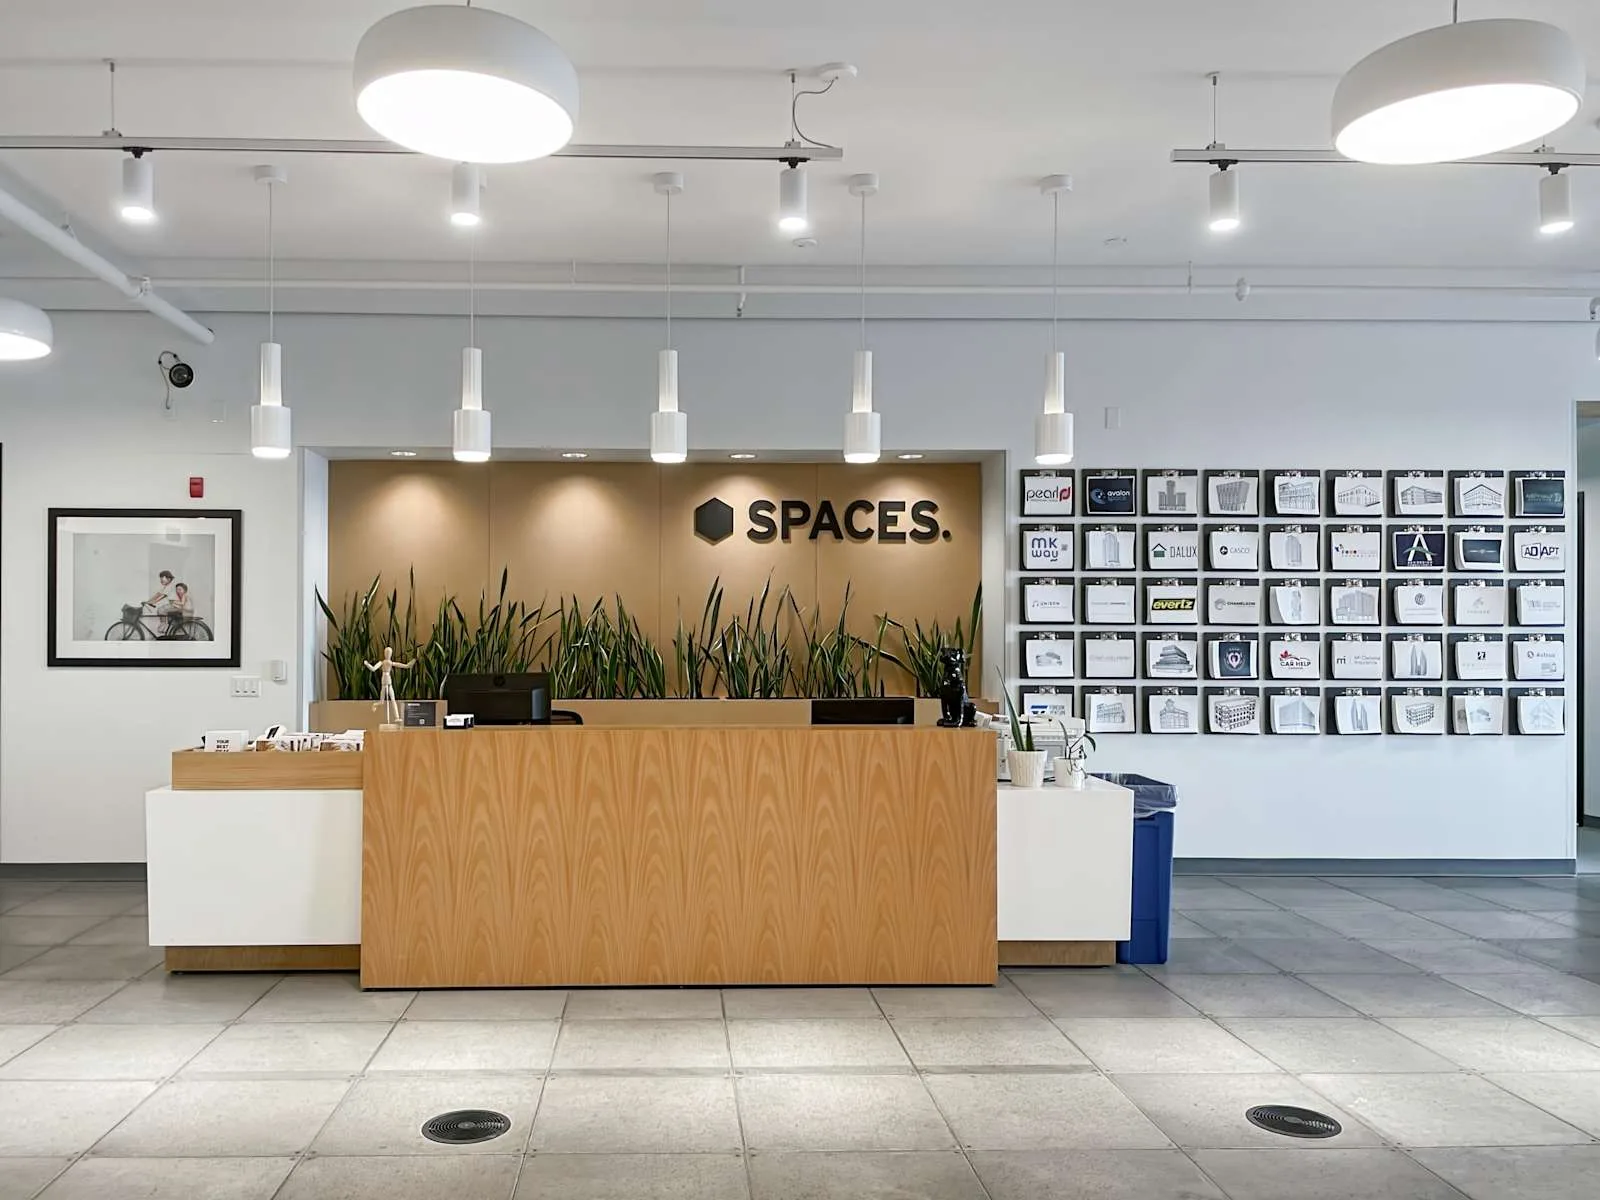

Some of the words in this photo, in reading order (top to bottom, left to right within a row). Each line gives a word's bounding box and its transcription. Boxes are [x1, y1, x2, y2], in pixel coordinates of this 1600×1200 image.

[1026, 486, 1059, 502] pearl
[1107, 489, 1130, 497] avalon
[1031, 550, 1059, 562] way
[1169, 546, 1198, 558] DALUX
[1152, 598, 1193, 609] evertz
